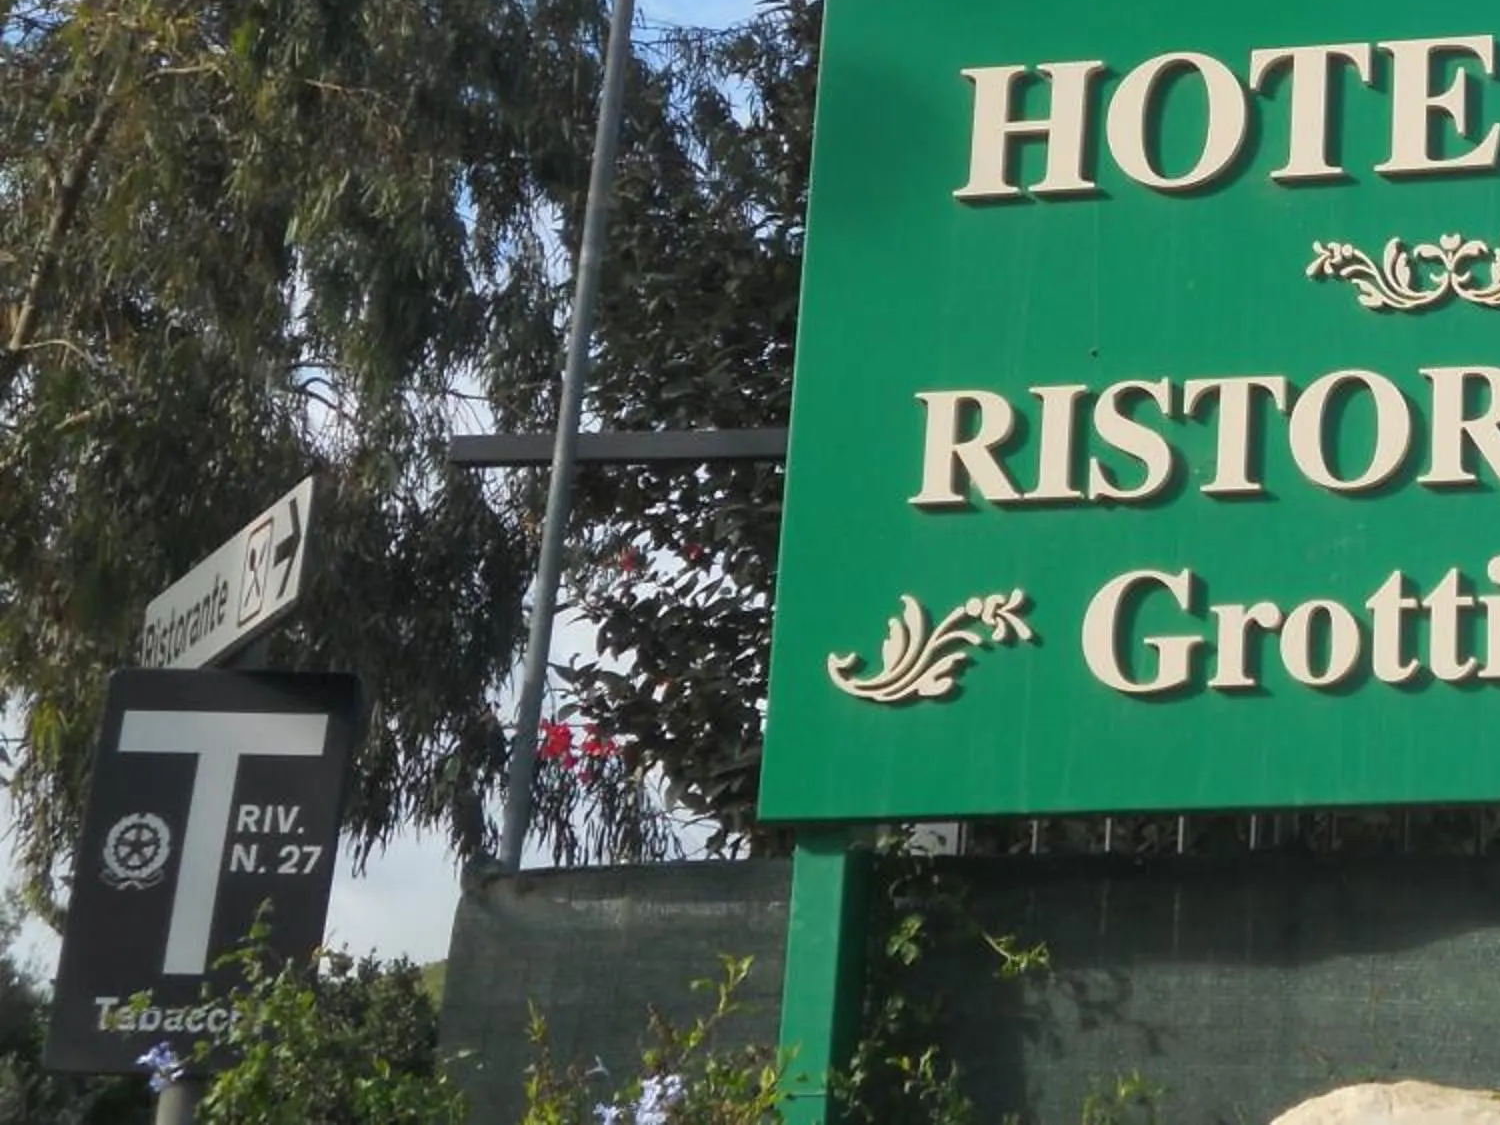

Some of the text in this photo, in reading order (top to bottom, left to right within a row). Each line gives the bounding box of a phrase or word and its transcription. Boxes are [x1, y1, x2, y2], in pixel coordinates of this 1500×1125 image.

[142, 574, 229, 668] Ristorante
[118, 710, 329, 975] T
[236, 804, 304, 834] RIV.
[229, 844, 322, 874] N. 27
